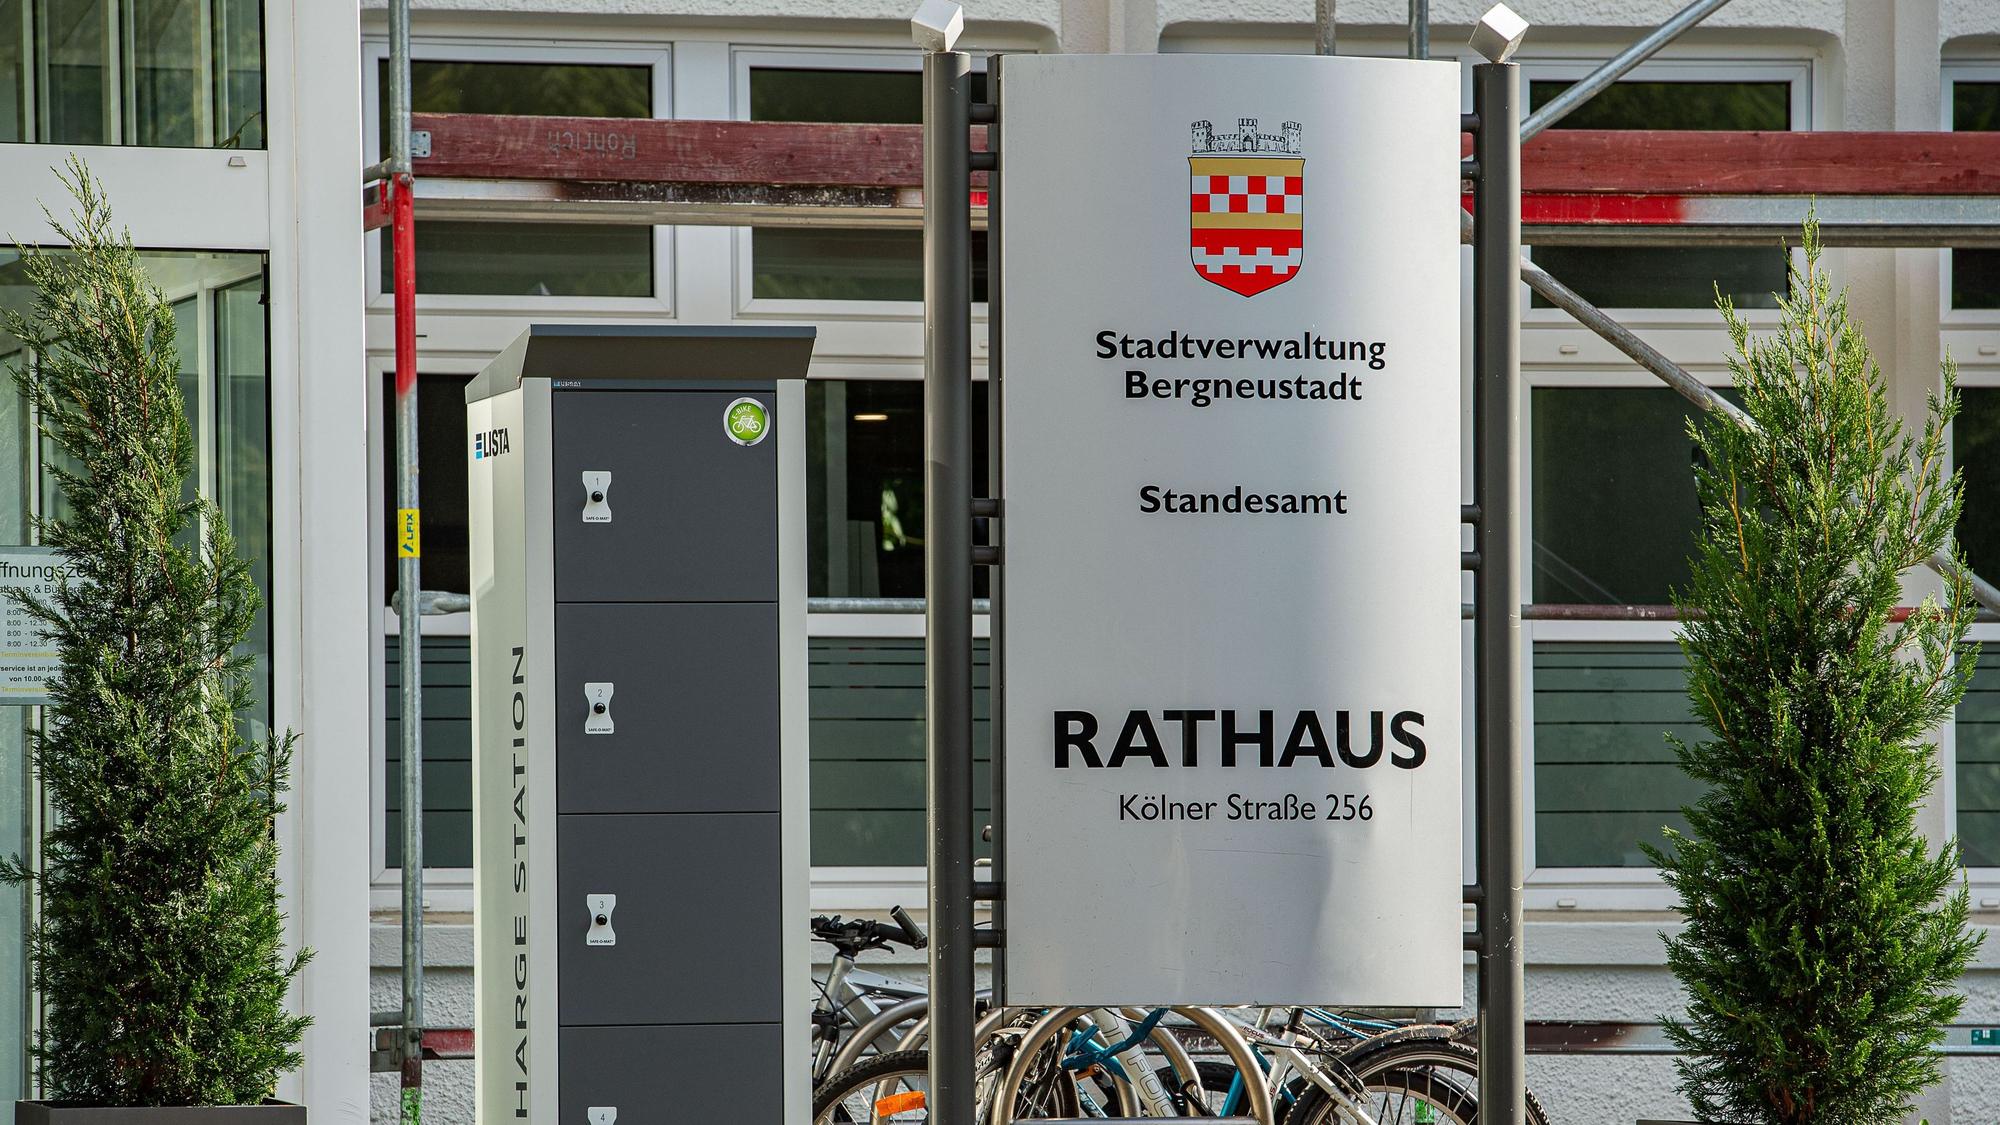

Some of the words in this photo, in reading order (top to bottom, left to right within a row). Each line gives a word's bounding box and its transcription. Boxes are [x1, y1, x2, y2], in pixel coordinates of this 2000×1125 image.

[1095, 330, 1387, 371] Stadtverwaltung
[1124, 370, 1363, 408] Bergneustadt
[732, 405, 752, 420] E-BIKE
[483, 427, 510, 458] LISTA
[1139, 485, 1348, 515] Standesamt
[33, 584, 42, 594] &
[0, 664, 26, 672] service
[27, 664, 36, 672] ist
[597, 688, 603, 698] 2
[1053, 710, 1427, 769] RATHAUS
[512, 646, 526, 893] STATION
[1119, 794, 1218, 821] Kölner
[1227, 794, 1316, 822] Straße
[1325, 794, 1374, 821] 256
[599, 900, 605, 910] 3
